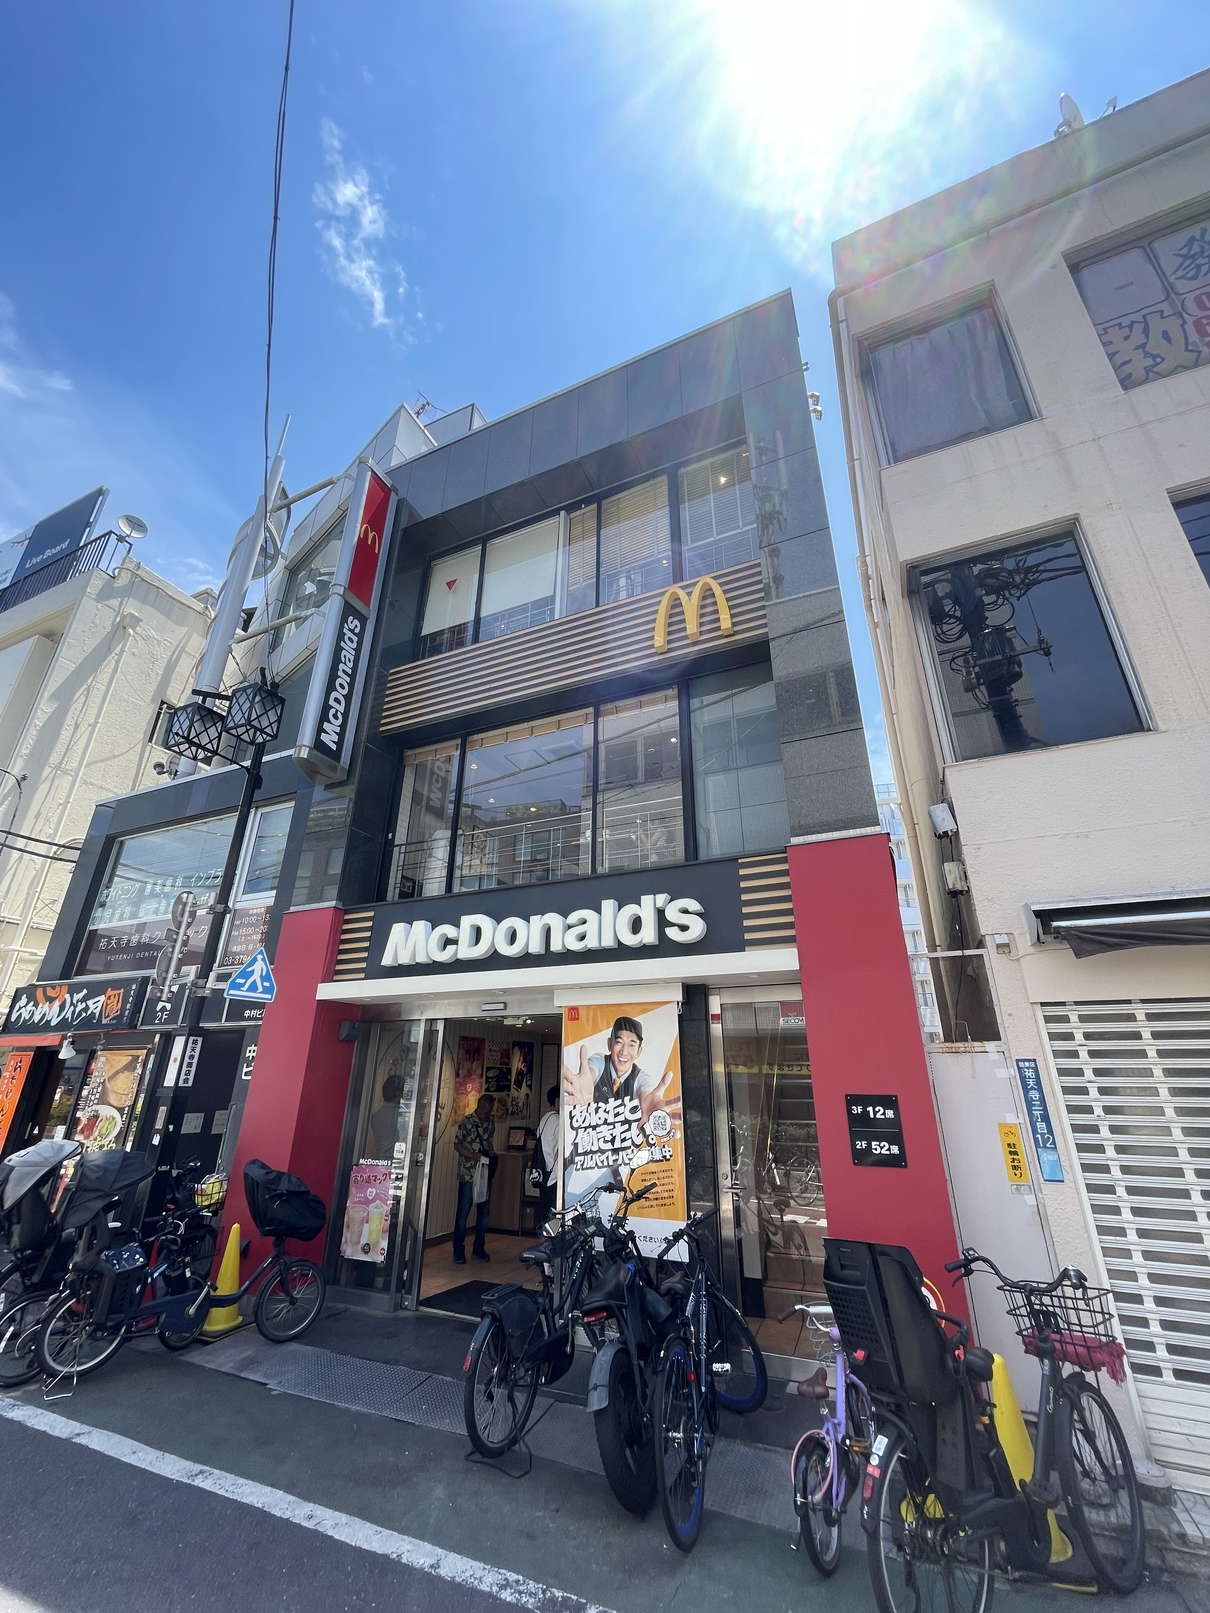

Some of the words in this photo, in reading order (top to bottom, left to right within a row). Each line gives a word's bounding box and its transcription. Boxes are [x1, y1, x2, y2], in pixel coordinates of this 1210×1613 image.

[319, 615, 363, 751] McDonald's
[380, 892, 708, 968] McDonald's
[154, 1011, 170, 1023] 2F
[571, 1095, 642, 1128] あなたと
[851, 1106, 863, 1114] 3F
[855, 1140, 868, 1149] 2F
